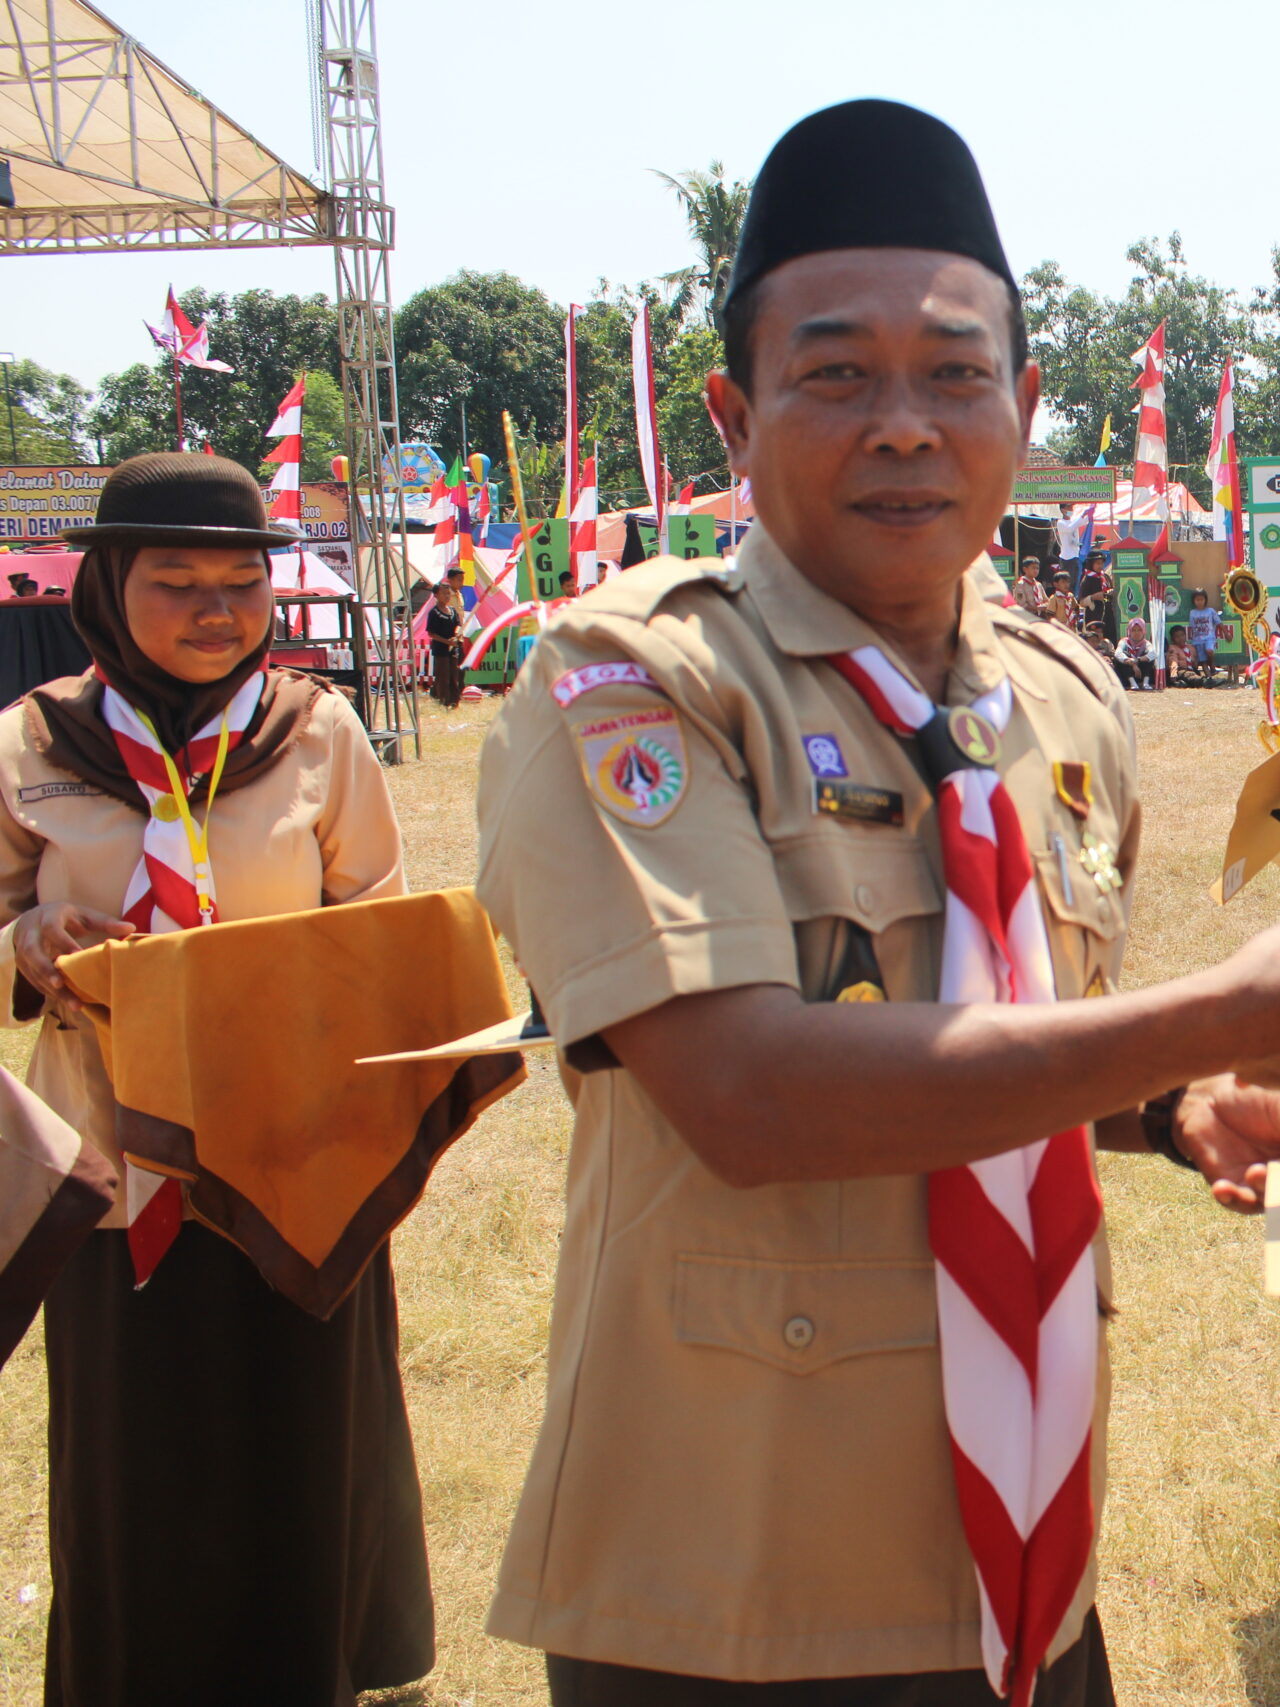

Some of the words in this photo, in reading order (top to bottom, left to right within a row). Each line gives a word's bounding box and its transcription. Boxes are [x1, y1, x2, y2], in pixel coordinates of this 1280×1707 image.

[0, 471, 55, 490] elamat
[58, 470, 108, 490] Datan
[10, 496, 48, 514] Depan
[0, 517, 23, 537] ERI
[301, 523, 328, 538] RJO
[331, 522, 347, 537] 02
[41, 785, 86, 796] SUSANTI
